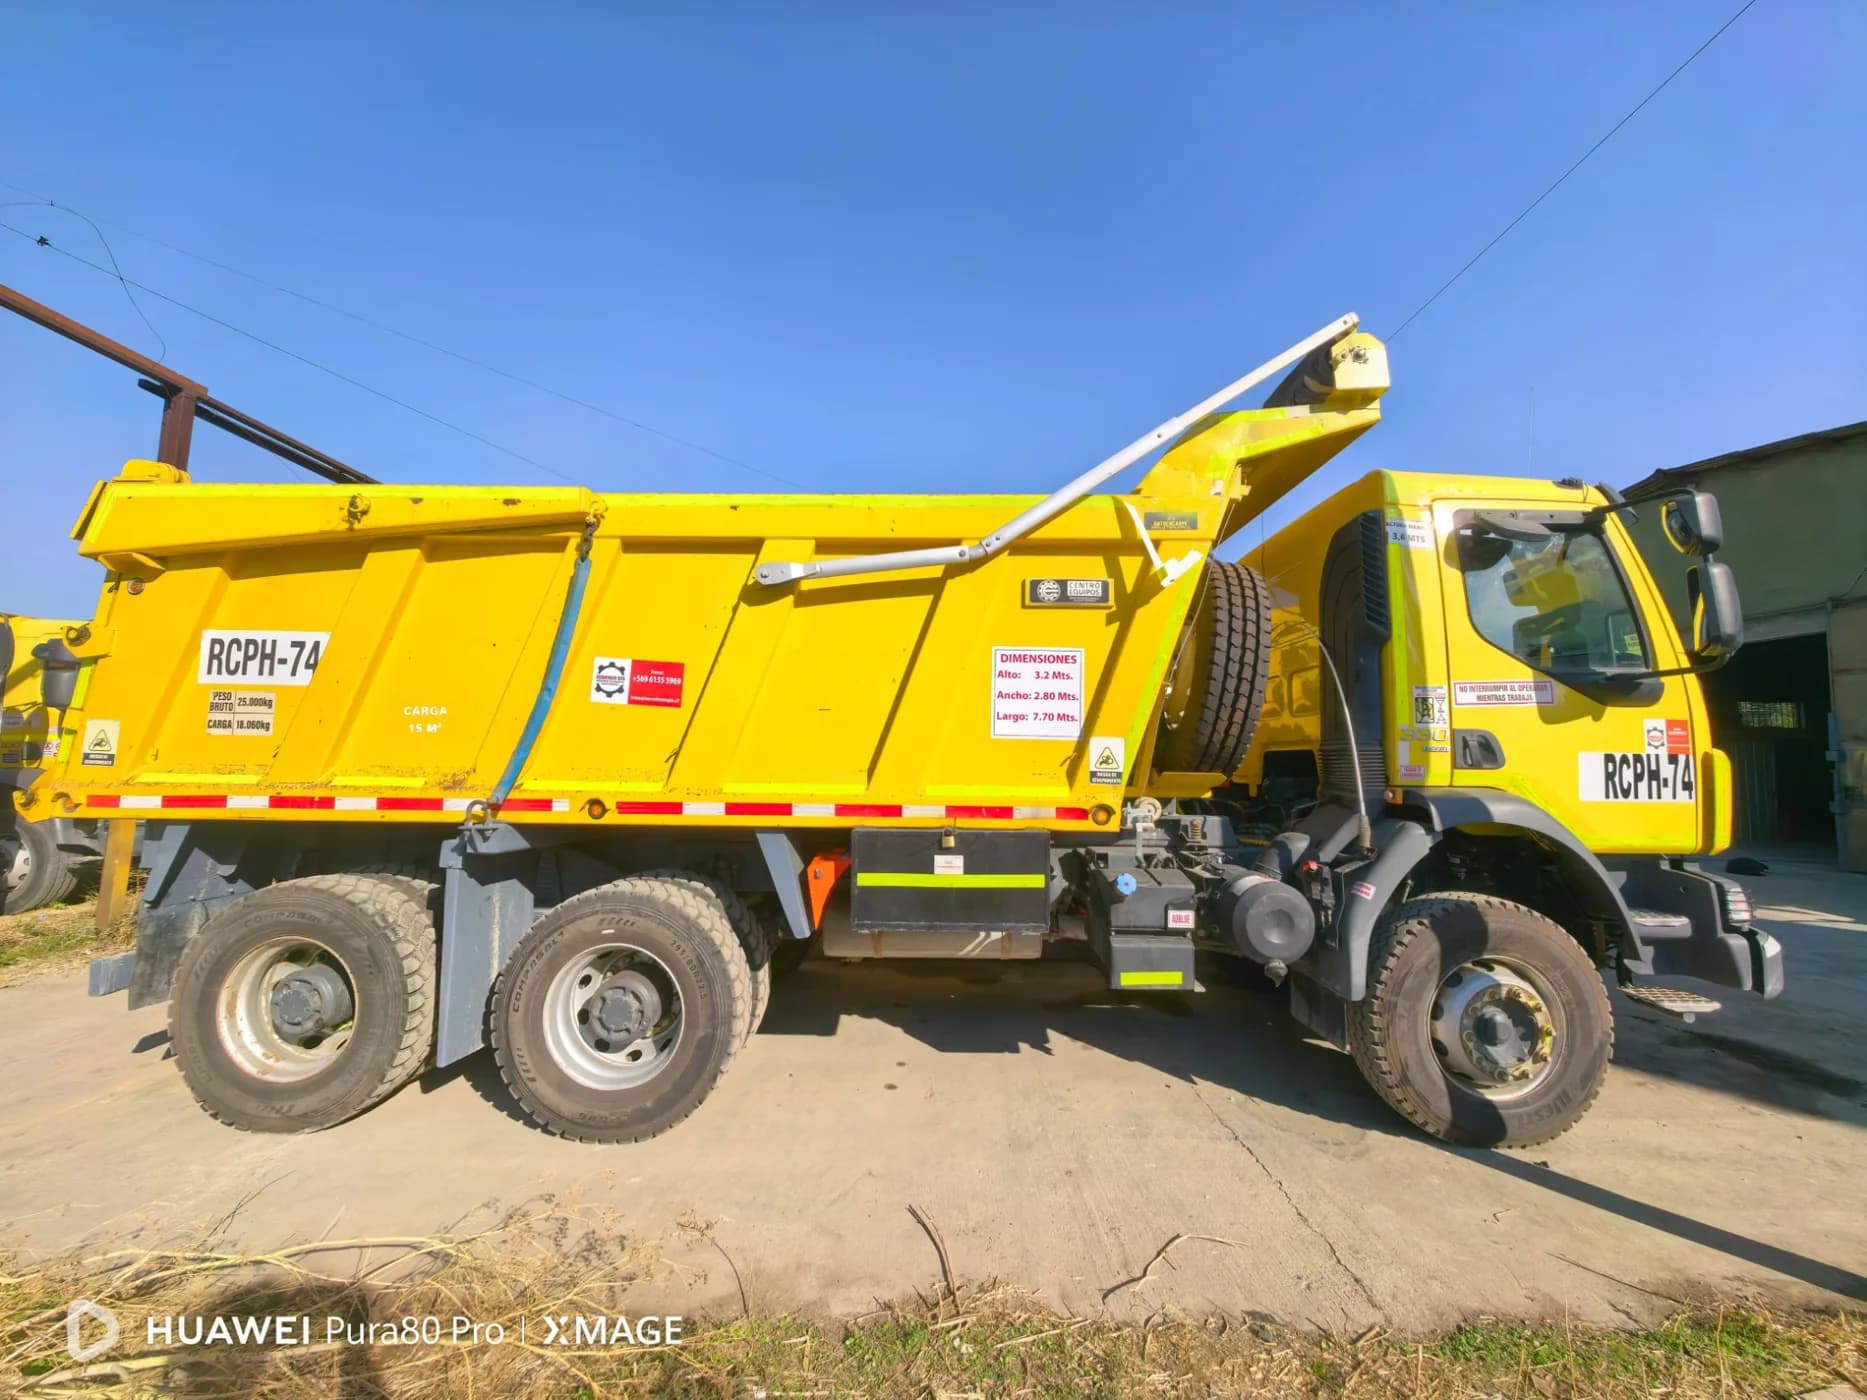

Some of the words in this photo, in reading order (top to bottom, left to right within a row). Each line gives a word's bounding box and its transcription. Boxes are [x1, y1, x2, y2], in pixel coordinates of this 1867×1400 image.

[206, 637, 321, 677] RCPH-74
[1000, 653, 1078, 664] DIMENSIONES
[997, 670, 1022, 679] Alto:
[1034, 671, 1050, 680] 3.2
[1052, 671, 1074, 680] Mts.
[1459, 685, 1468, 693] NO
[1510, 684, 1517, 692] AL
[1518, 684, 1548, 692] OPERADOR
[212, 691, 232, 701] PESO
[997, 691, 1032, 700] Ancho:
[1033, 692, 1056, 700] 2.80
[1057, 692, 1079, 701] Mts.
[1476, 694, 1506, 702] MIENTRAS
[1507, 693, 1533, 701] TRABAJA
[209, 702, 234, 712] BRUTO
[237, 697, 273, 709] 25.000kg
[403, 705, 448, 716] CARGA
[996, 712, 1029, 723] Largo:
[1032, 713, 1055, 722] 7.70
[1056, 713, 1078, 722] Mts.
[207, 719, 232, 729] CARGA
[409, 723, 423, 733] 15
[1603, 753, 1694, 800] RCPH-74
